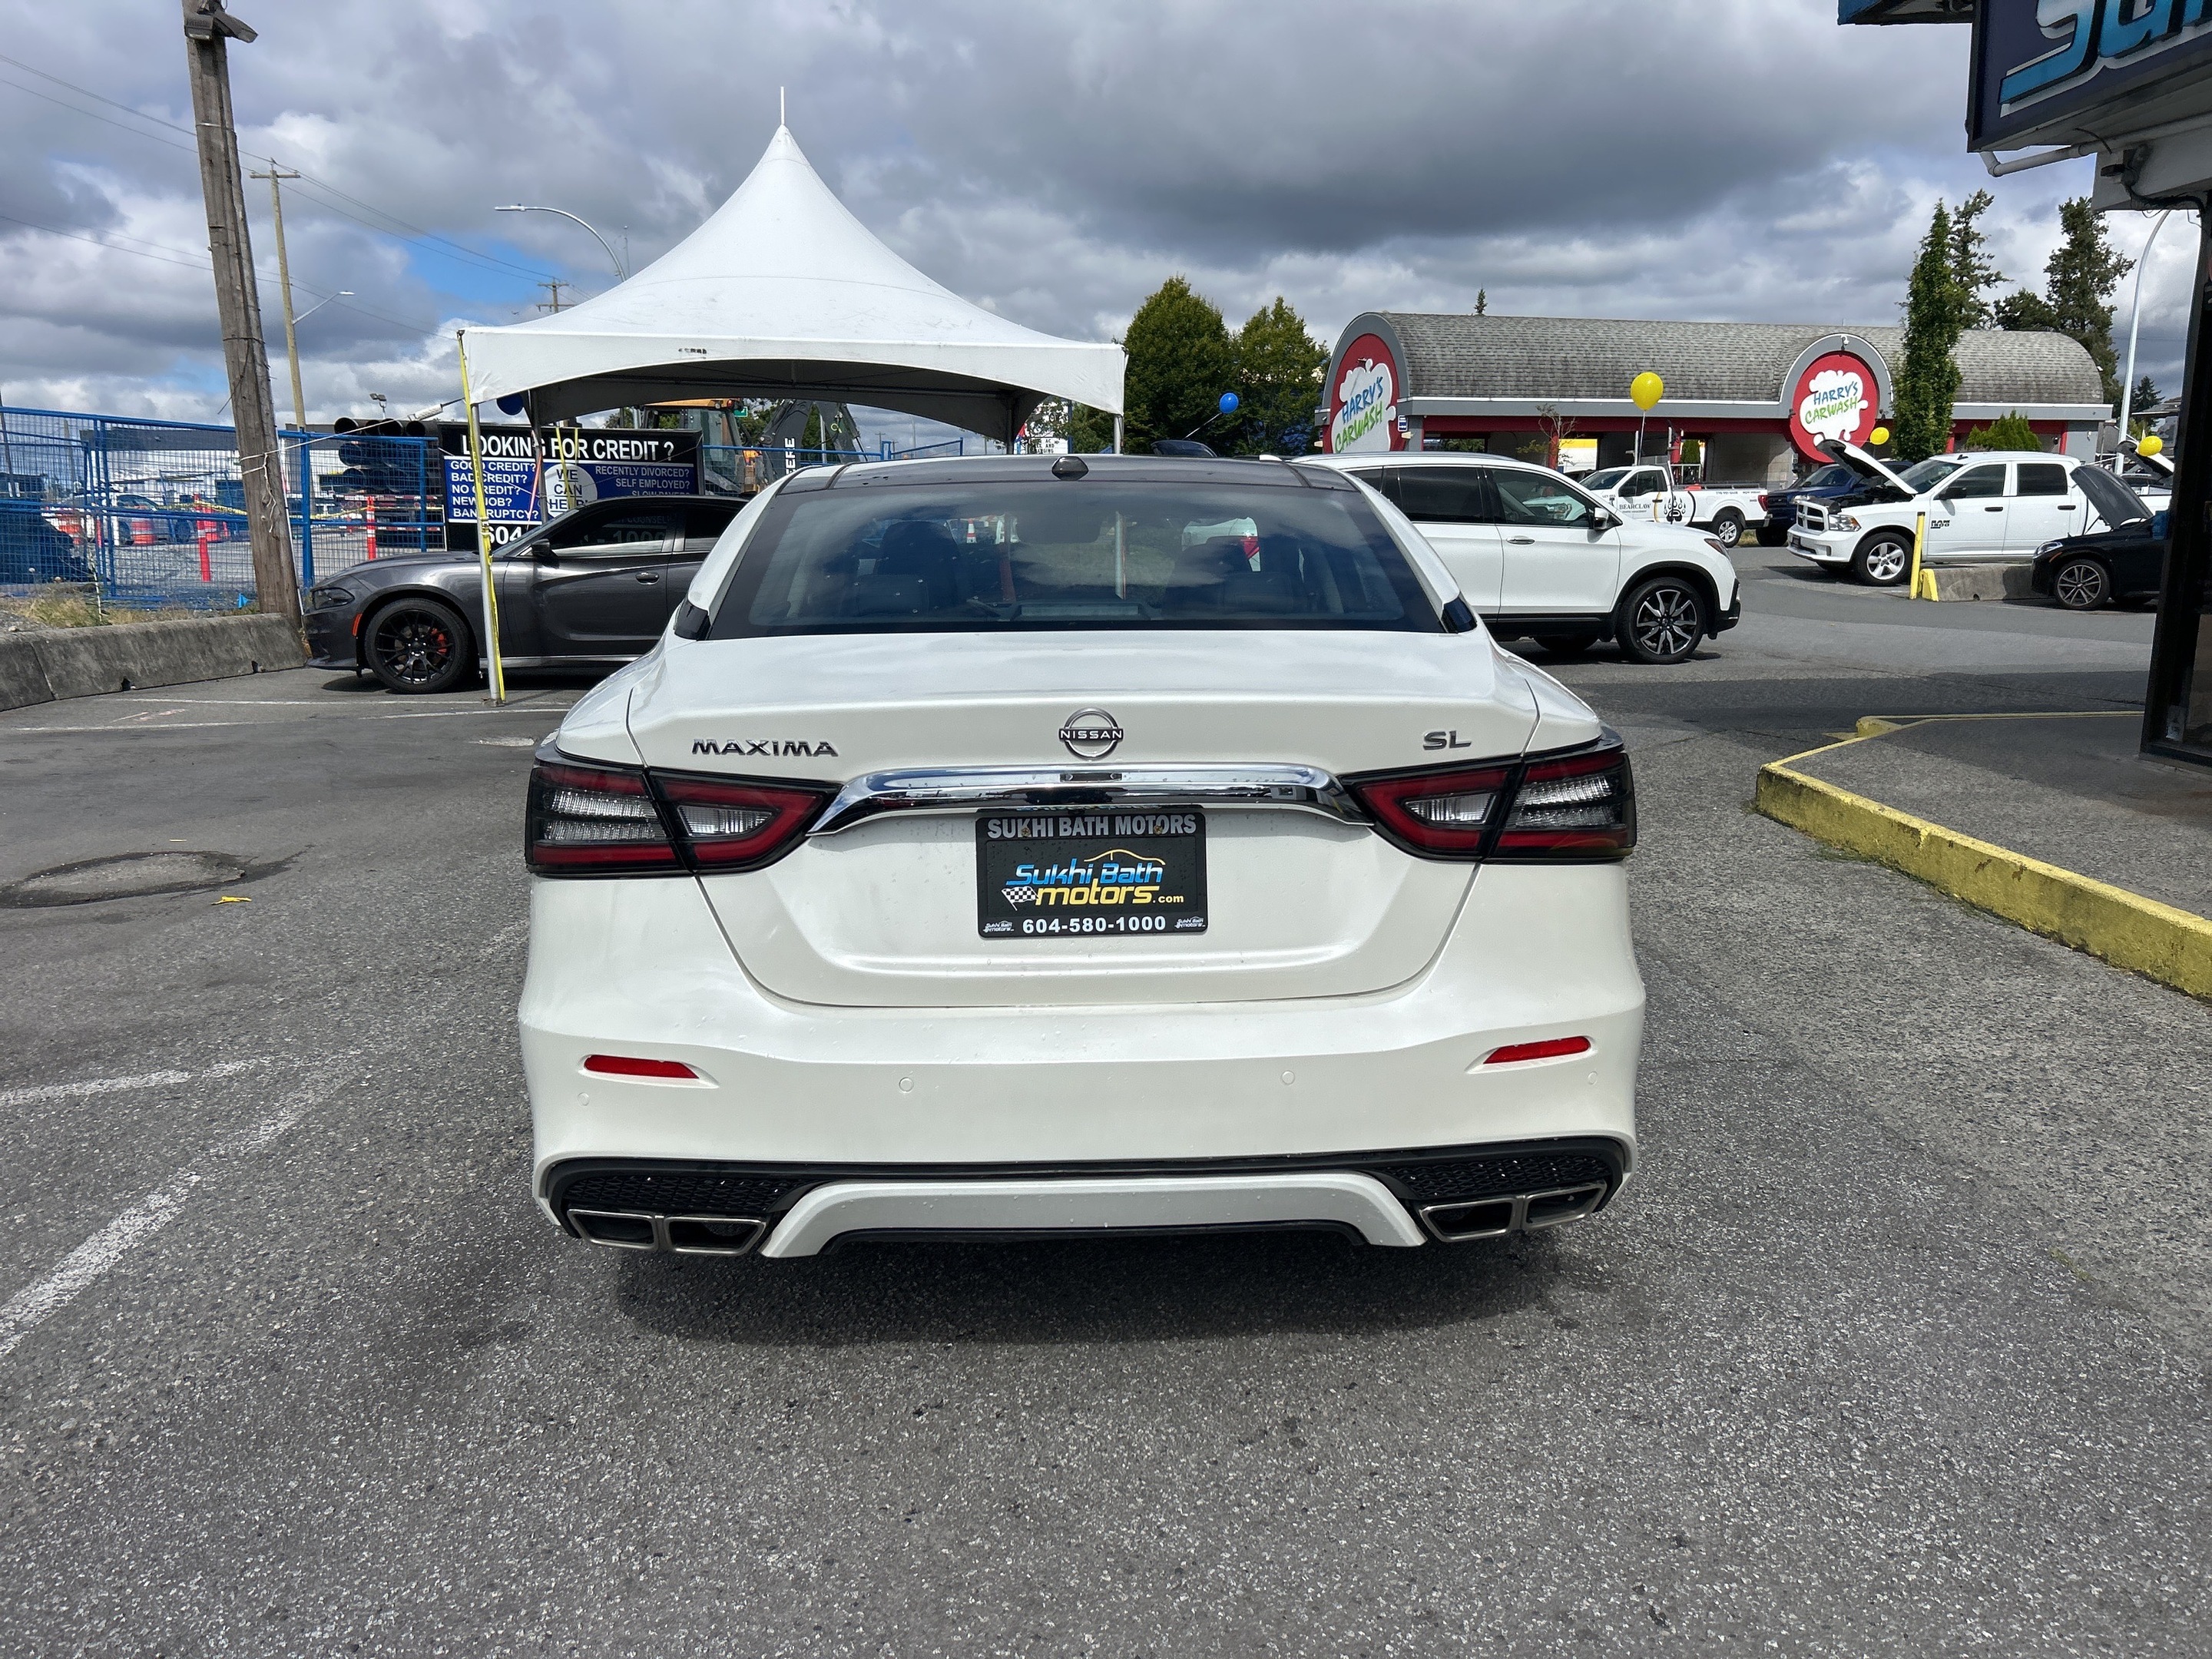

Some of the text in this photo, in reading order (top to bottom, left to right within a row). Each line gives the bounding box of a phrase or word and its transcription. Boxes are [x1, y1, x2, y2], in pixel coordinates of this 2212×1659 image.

[1341, 376, 1383, 424] HARRY'S
[1813, 381, 1859, 405] HARRY'S
[1805, 396, 1858, 424] CARWASH
[1335, 401, 1383, 454] CARWASH
[551, 438, 589, 459] FOR
[593, 439, 659, 461] CREDIT
[664, 441, 674, 462] ?
[488, 462, 536, 472] CREDIT?
[556, 469, 578, 480] WE
[595, 465, 690, 478] RECENTLY DIVORCED?
[452, 484, 469, 494] NO
[554, 484, 583, 495] CAN
[615, 478, 690, 490] SELF EMPLOYED?
[453, 508, 539, 519] BANRUPTCY?
[1060, 730, 1122, 740] NISSAN
[1422, 730, 1472, 750] SL
[691, 738, 839, 757] MAXIMA
[987, 814, 1197, 839] SUKHI BATH MOTORS
[1005, 857, 1164, 886] Sukhi Bath
[1022, 916, 1166, 934] 604-580-1000
